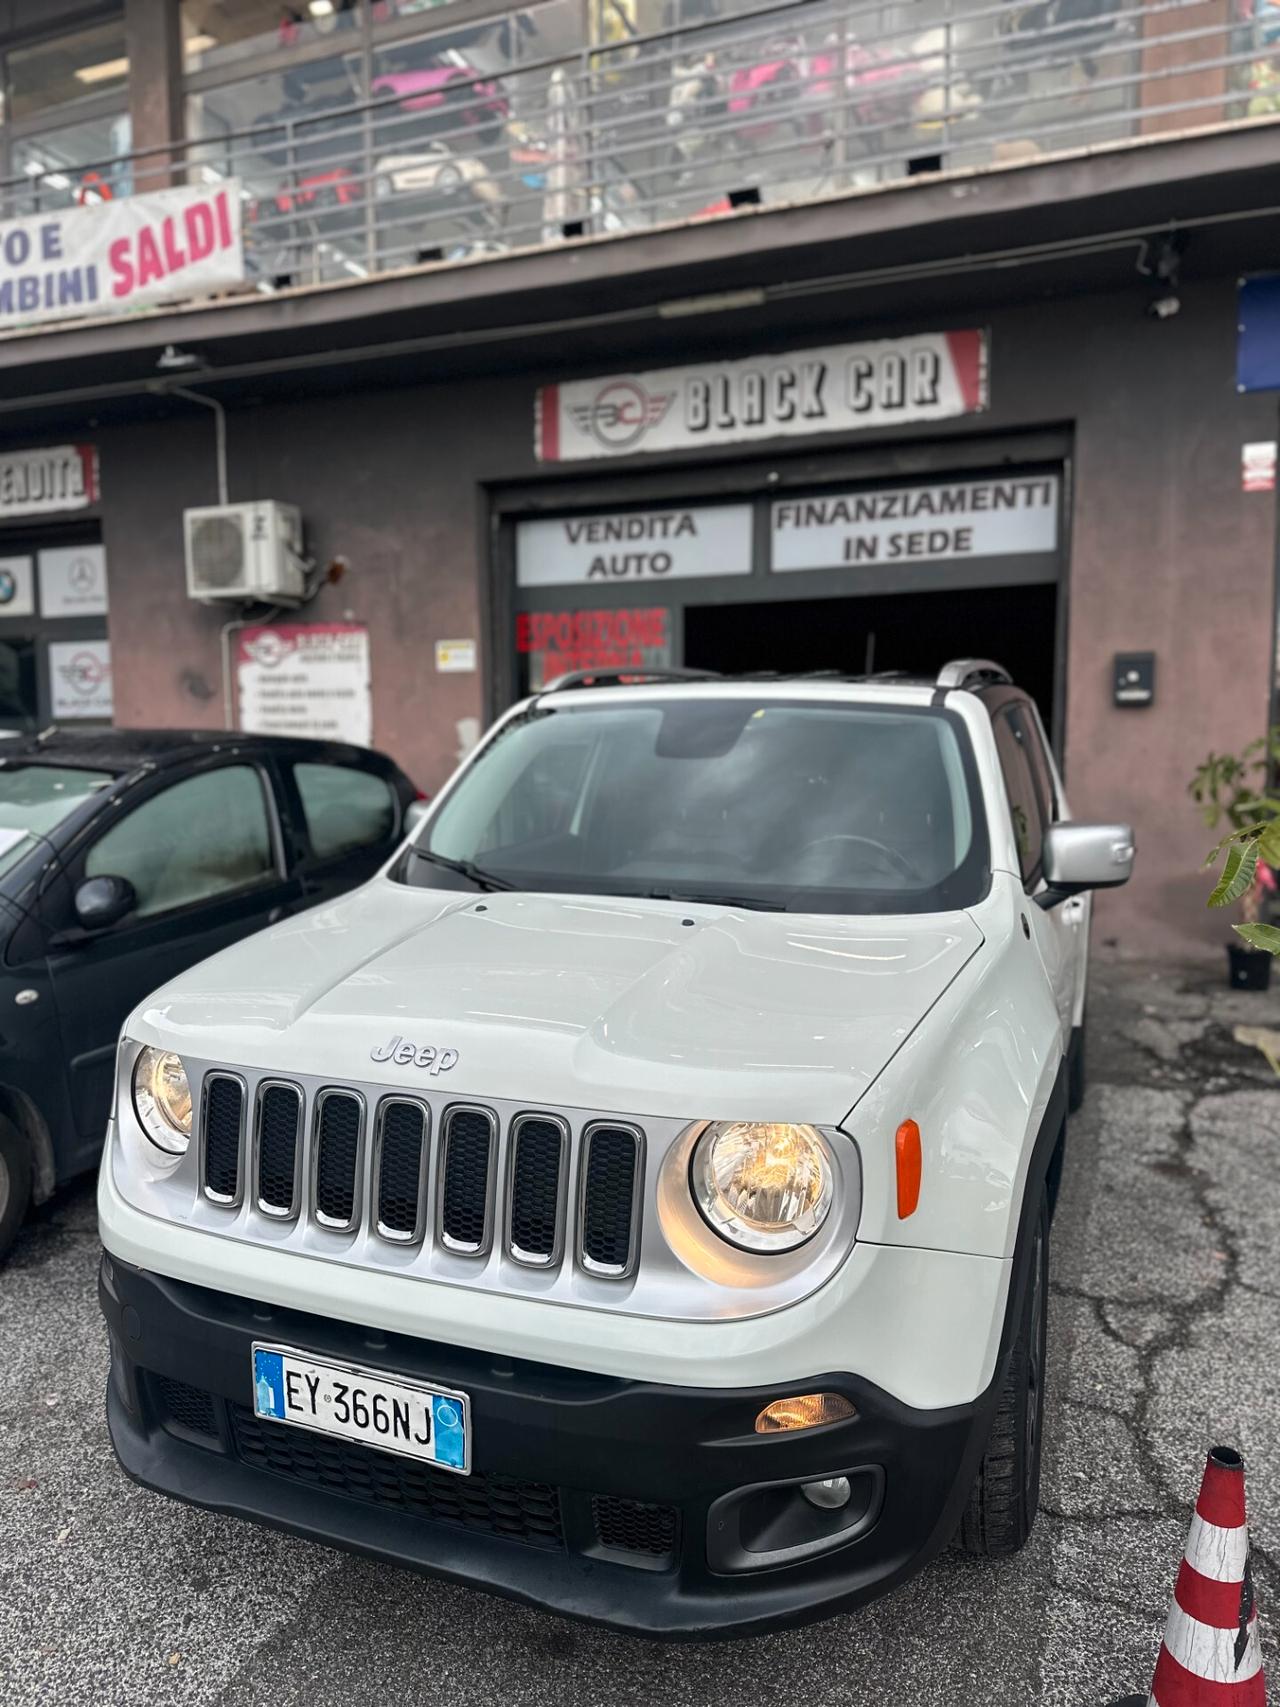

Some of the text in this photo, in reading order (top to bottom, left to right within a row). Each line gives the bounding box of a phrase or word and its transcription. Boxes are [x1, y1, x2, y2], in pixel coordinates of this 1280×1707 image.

[0, 223, 62, 266] O E
[108, 191, 232, 298] SALDI
[682, 346, 942, 432] BLACK CAR
[776, 481, 1052, 530] FINANZIAMENTI
[565, 513, 697, 545] VENDITA
[843, 528, 974, 561] IN SEDE
[588, 551, 673, 578] AUTO
[516, 607, 668, 653] ESPOSIZIONE
[370, 1035, 460, 1076] Jeep
[286, 1369, 432, 1445] EY 366NJ
